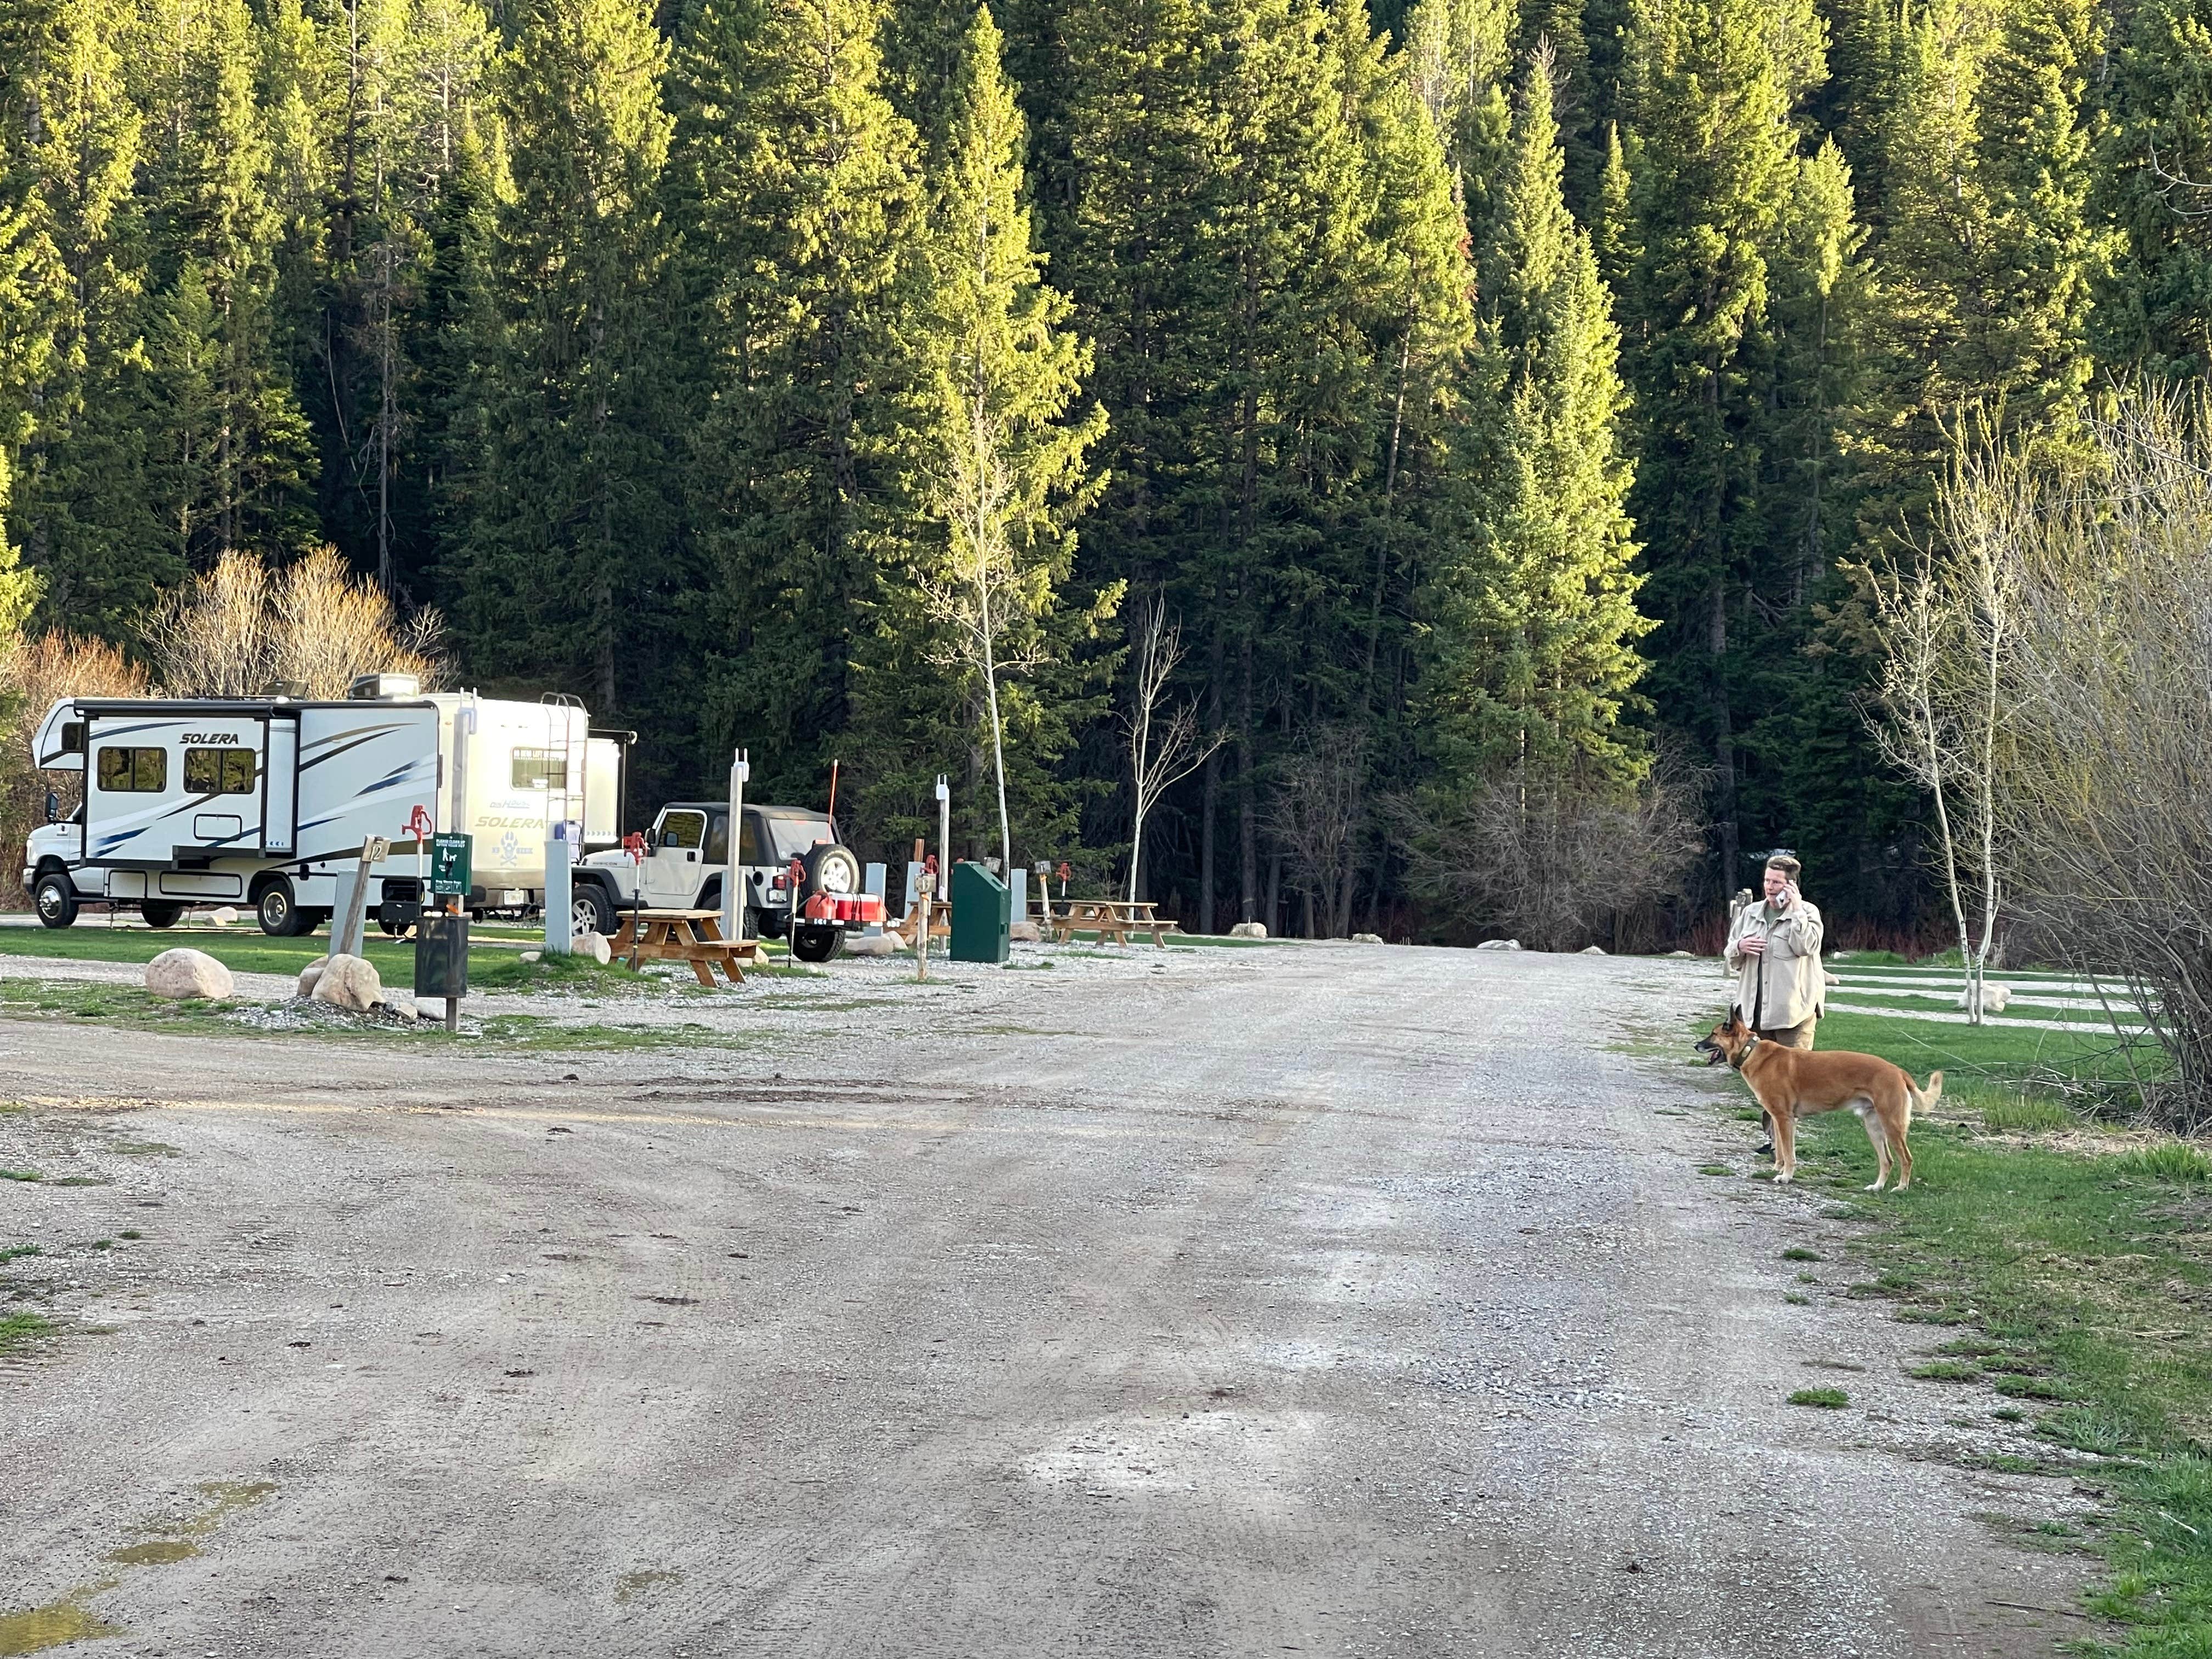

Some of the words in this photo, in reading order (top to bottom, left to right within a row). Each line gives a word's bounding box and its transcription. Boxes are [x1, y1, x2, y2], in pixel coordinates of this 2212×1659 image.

[179, 733, 239, 744] SOLERA
[474, 816, 544, 829] SOLERA
[370, 846, 382, 860] 12
